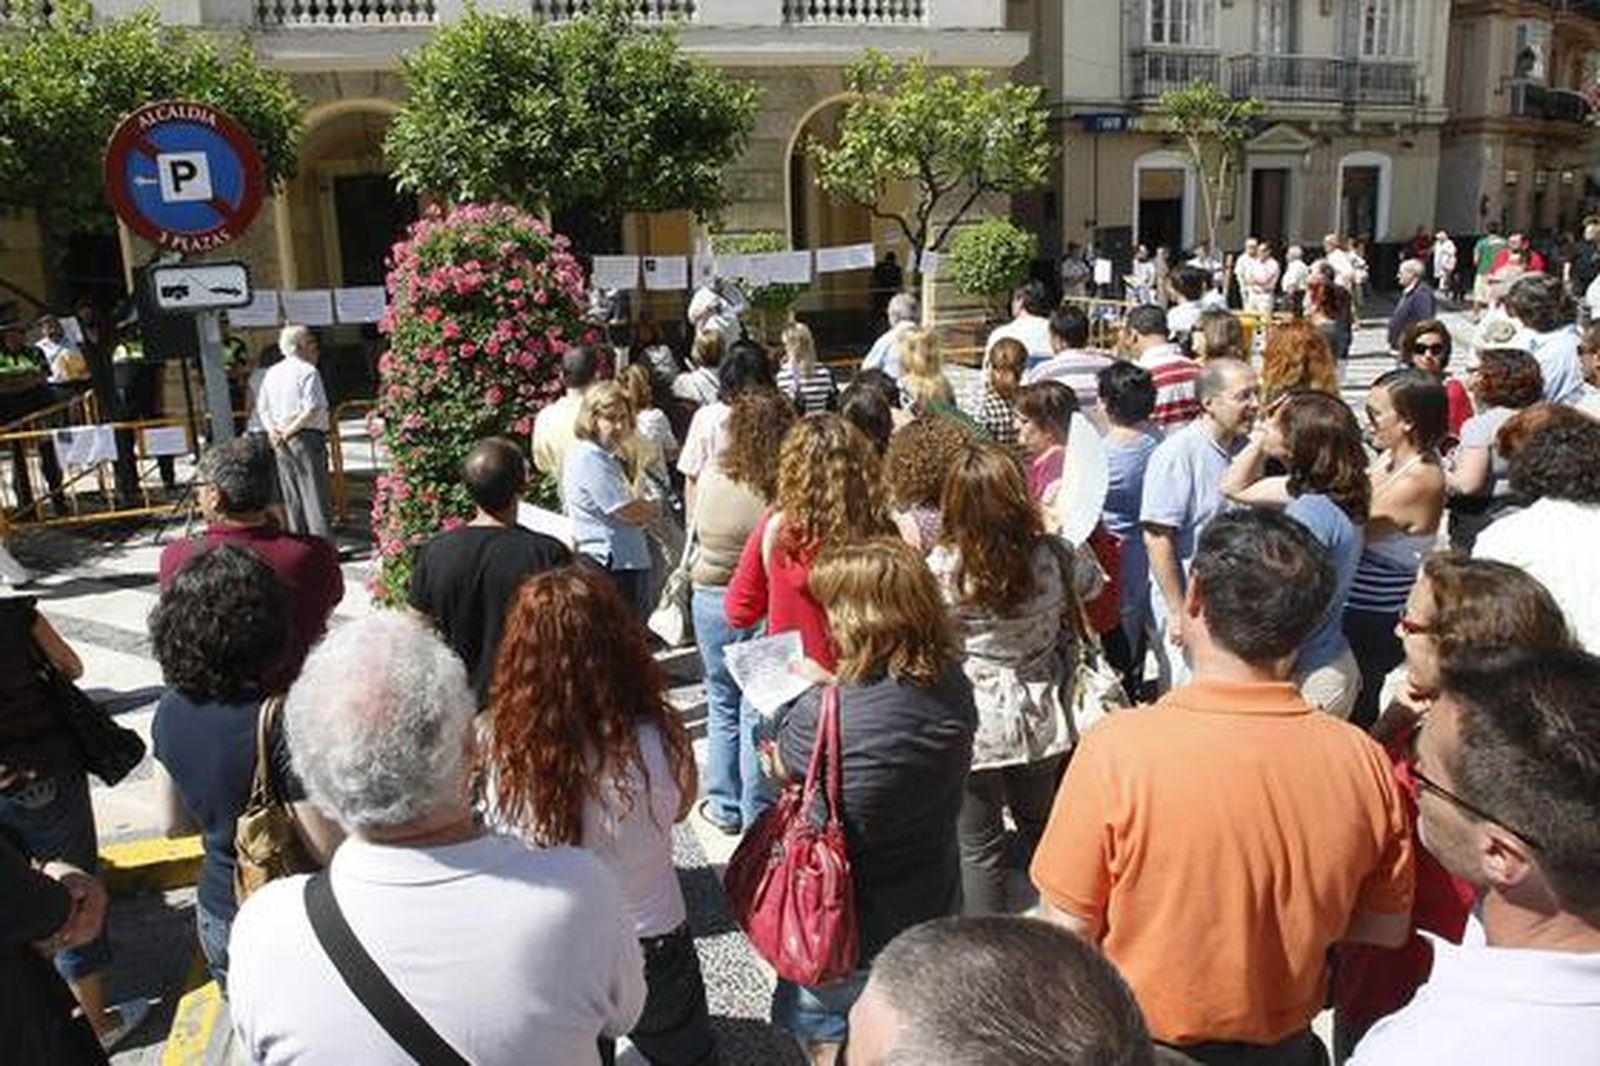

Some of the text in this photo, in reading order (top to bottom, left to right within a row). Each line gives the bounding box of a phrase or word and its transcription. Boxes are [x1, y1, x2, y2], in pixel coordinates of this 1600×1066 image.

[138, 105, 217, 127] ALCALDIA
[171, 161, 198, 193] P
[171, 229, 230, 253] PLAZAS
